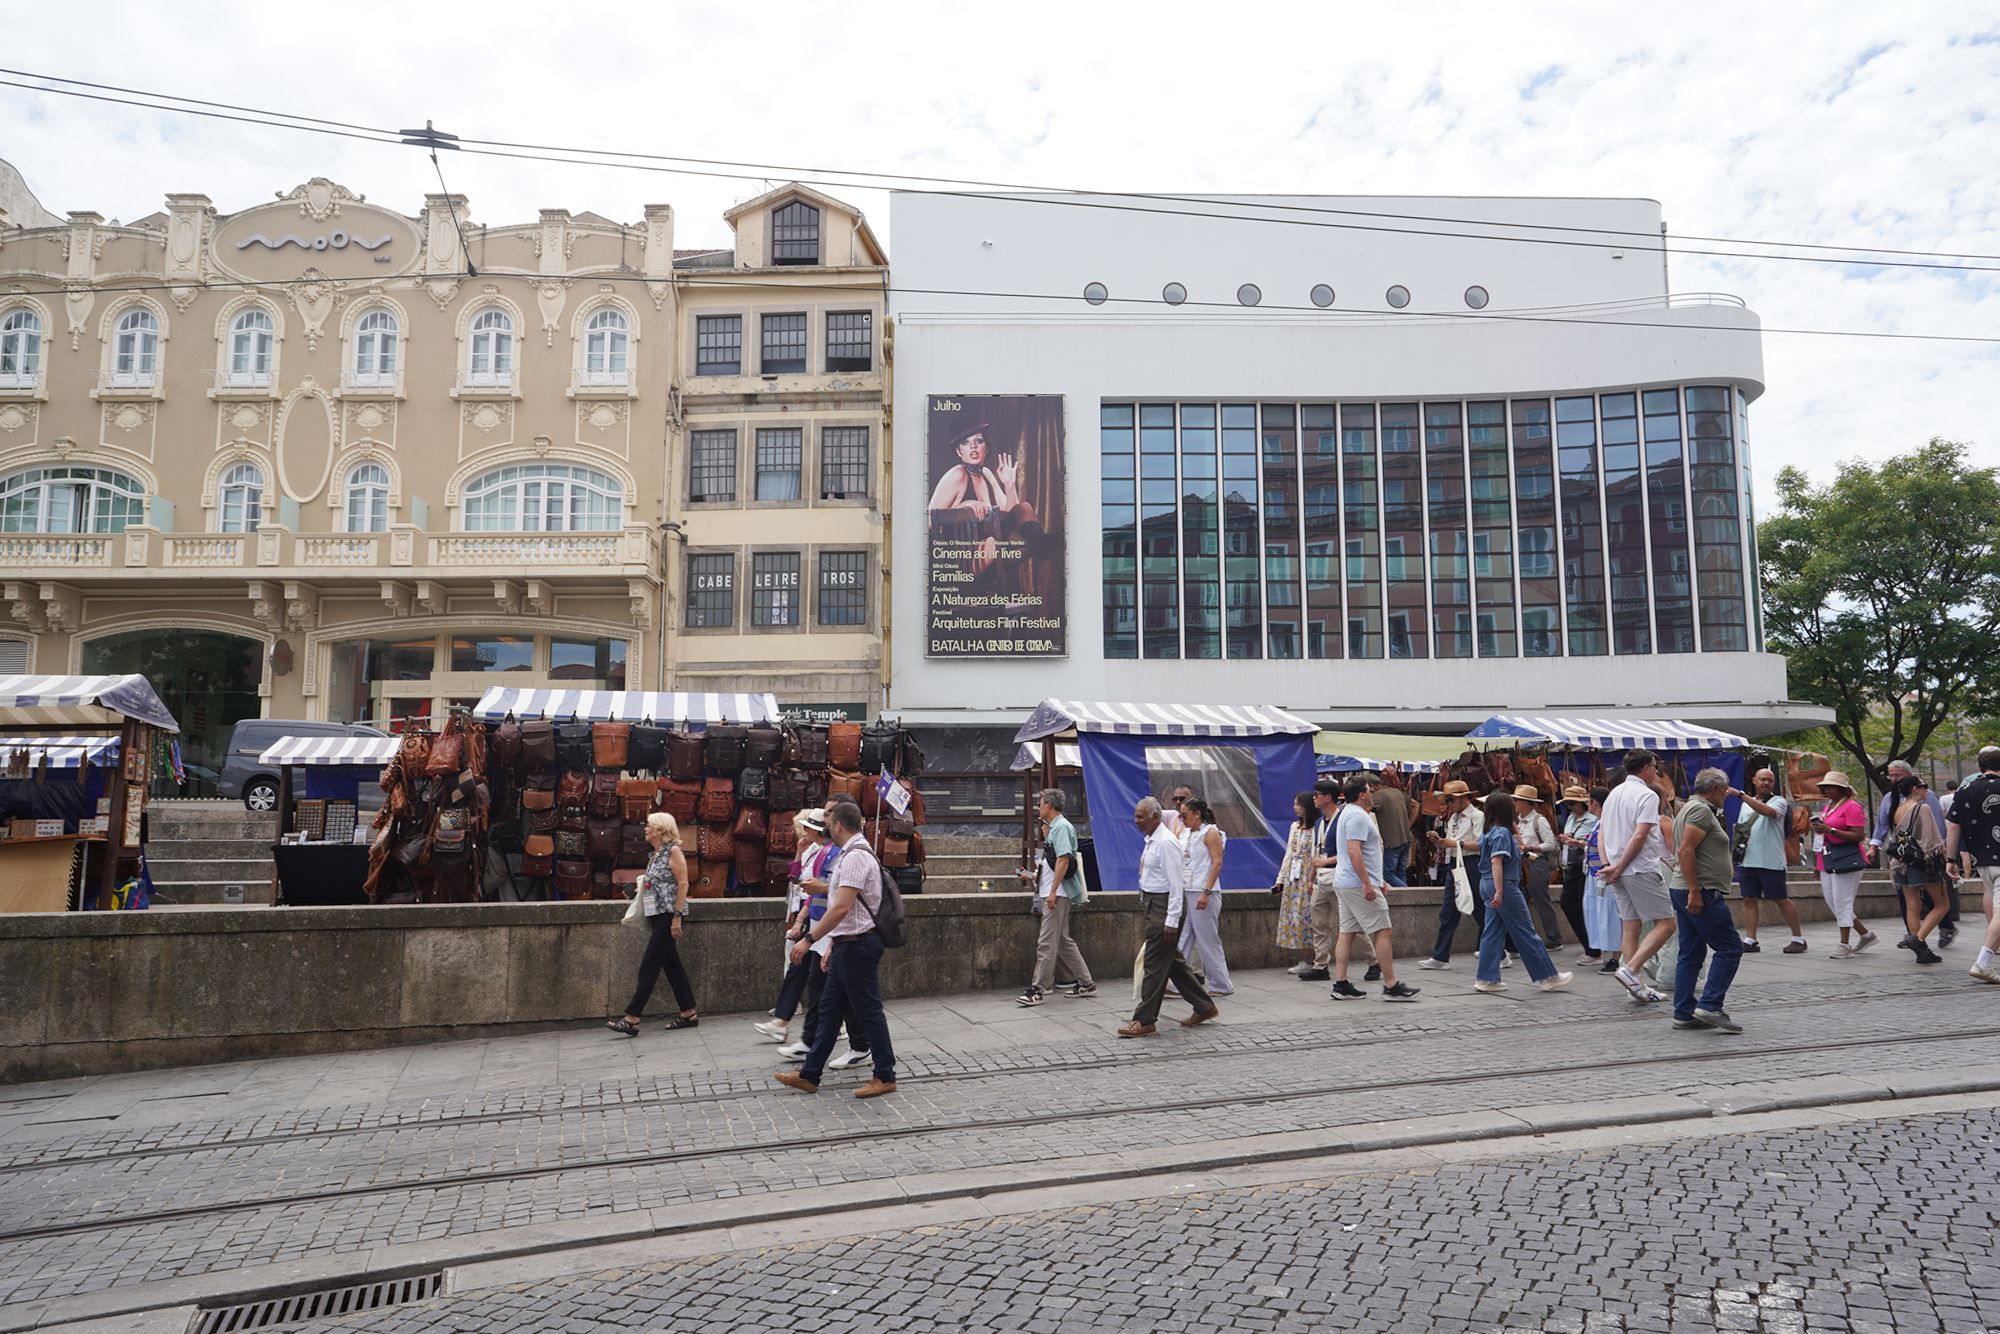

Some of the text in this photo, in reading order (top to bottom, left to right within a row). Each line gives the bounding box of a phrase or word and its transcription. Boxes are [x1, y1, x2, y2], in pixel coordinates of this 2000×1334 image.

[933, 400, 961, 411] Julho
[932, 547, 1022, 559] Cinema ao ar livre
[698, 571, 855, 588] CABE LEIRE IROS
[932, 570, 974, 582] Famílias
[932, 594, 1042, 605] A Natureza das Férias
[932, 617, 1061, 631] Arquiteturas Film Festival
[932, 640, 985, 652] BATALHA
[803, 709, 848, 721] Temple
